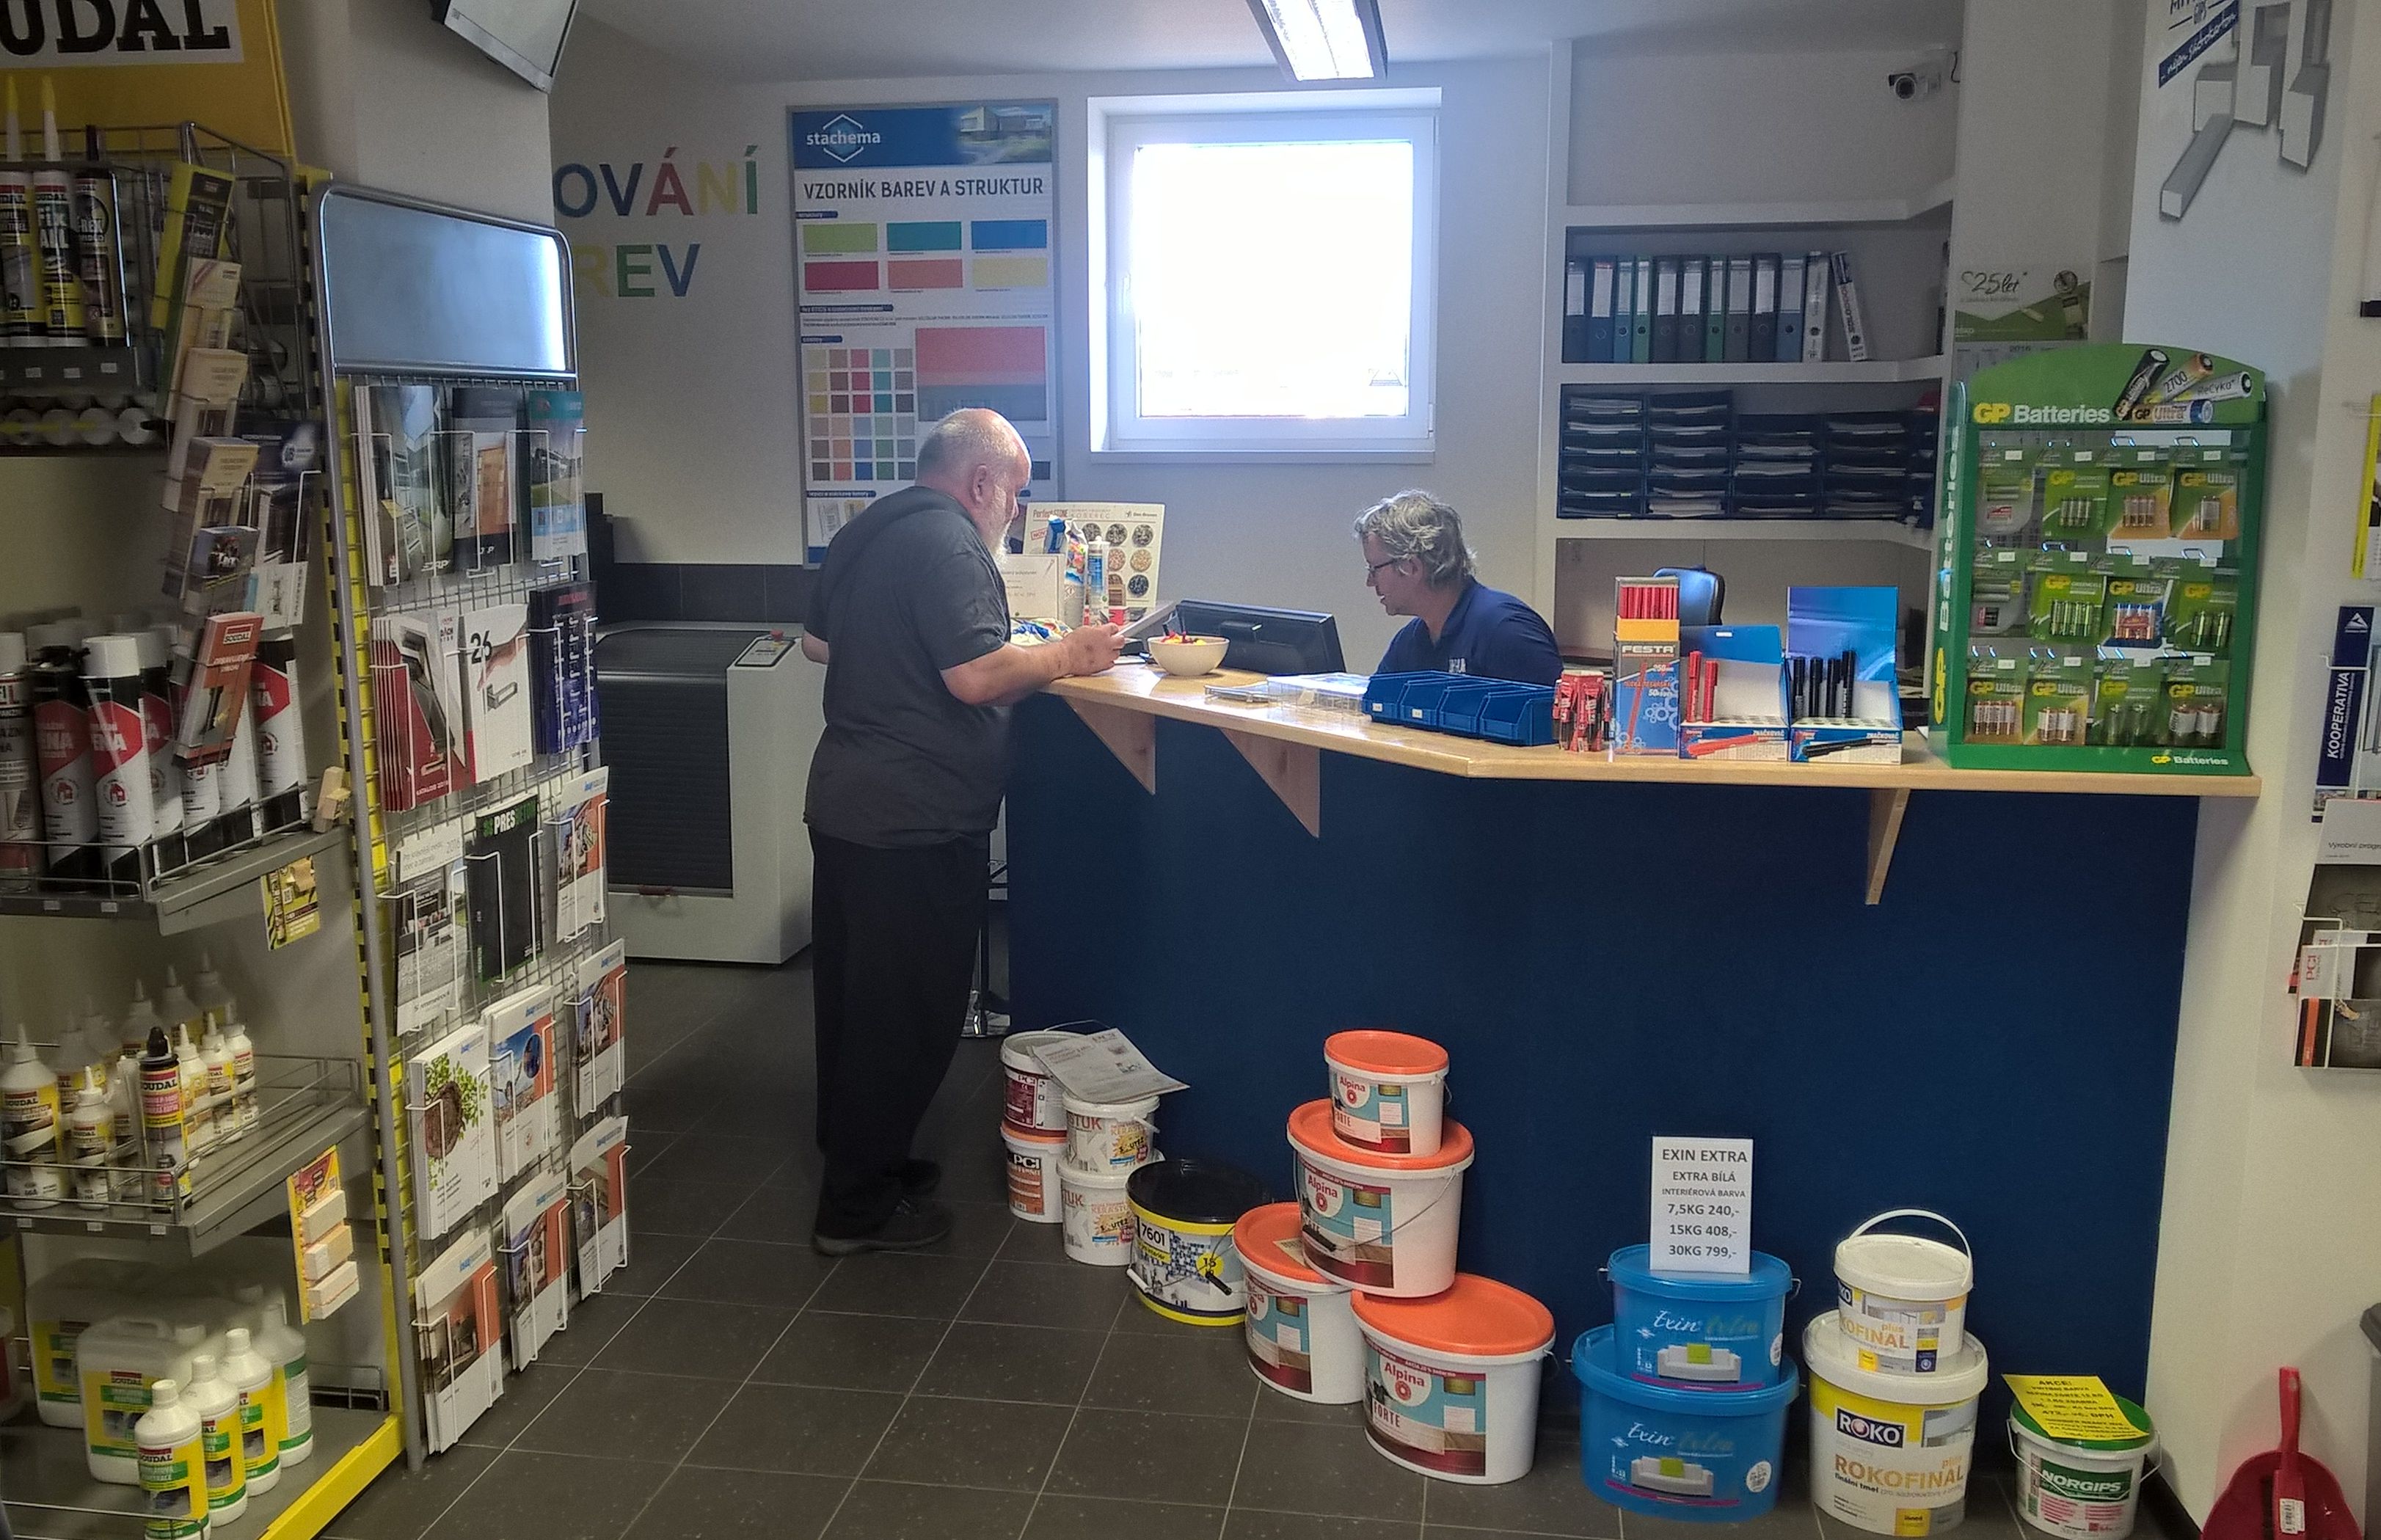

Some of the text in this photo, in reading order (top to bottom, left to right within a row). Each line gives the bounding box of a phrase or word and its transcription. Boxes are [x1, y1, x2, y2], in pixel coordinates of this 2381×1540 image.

[806, 130, 881, 145] stachema
[804, 178, 1043, 200] VZORNÍK BAREV A STRUKTUR
[2165, 371, 2188, 393] 2700
[1973, 403, 2110, 424] GP Batteries
[2112, 472, 2167, 486] GP Ultra
[2181, 472, 2235, 486] GP Ultra
[2110, 580, 2162, 596] GP Ultra
[1622, 645, 1674, 654] FESTA
[1969, 680, 2022, 695] GP Ultra
[2032, 681, 2084, 696] GP Ultra
[2169, 684, 2222, 698] GP Ultra
[2327, 672, 2350, 759] KOOPERATIVA
[2151, 756, 2229, 765] GP Batteries
[2305, 955, 2317, 981] PCI
[1340, 1076, 1365, 1092] Alpina
[1013, 1154, 1040, 1169] PCI
[1662, 1149, 1748, 1162] EXIN EXTRA
[1672, 1170, 1736, 1182] EXTRA BÍLÁ
[1308, 1175, 1338, 1198] Alpina
[1662, 1187, 1716, 1197] INTERIÉROVÁ
[1667, 1204, 1740, 1217] 7,5KG 240,-
[1142, 1222, 1165, 1246] 7601
[1669, 1224, 1738, 1238] 15KG 408,-
[1669, 1245, 1737, 1258] 30KG 799,-
[1653, 1310, 1698, 1332] Exin
[1881, 1323, 1904, 1332] plus
[1384, 1362, 1425, 1387] Alpina
[1374, 1401, 1401, 1427] FORTE
[1627, 1422, 1673, 1446] Exin
[1839, 1413, 1900, 1444] ROKO
[1836, 1454, 1963, 1489] ROKOFINAL
[2041, 1470, 2122, 1492] NORGIPS
